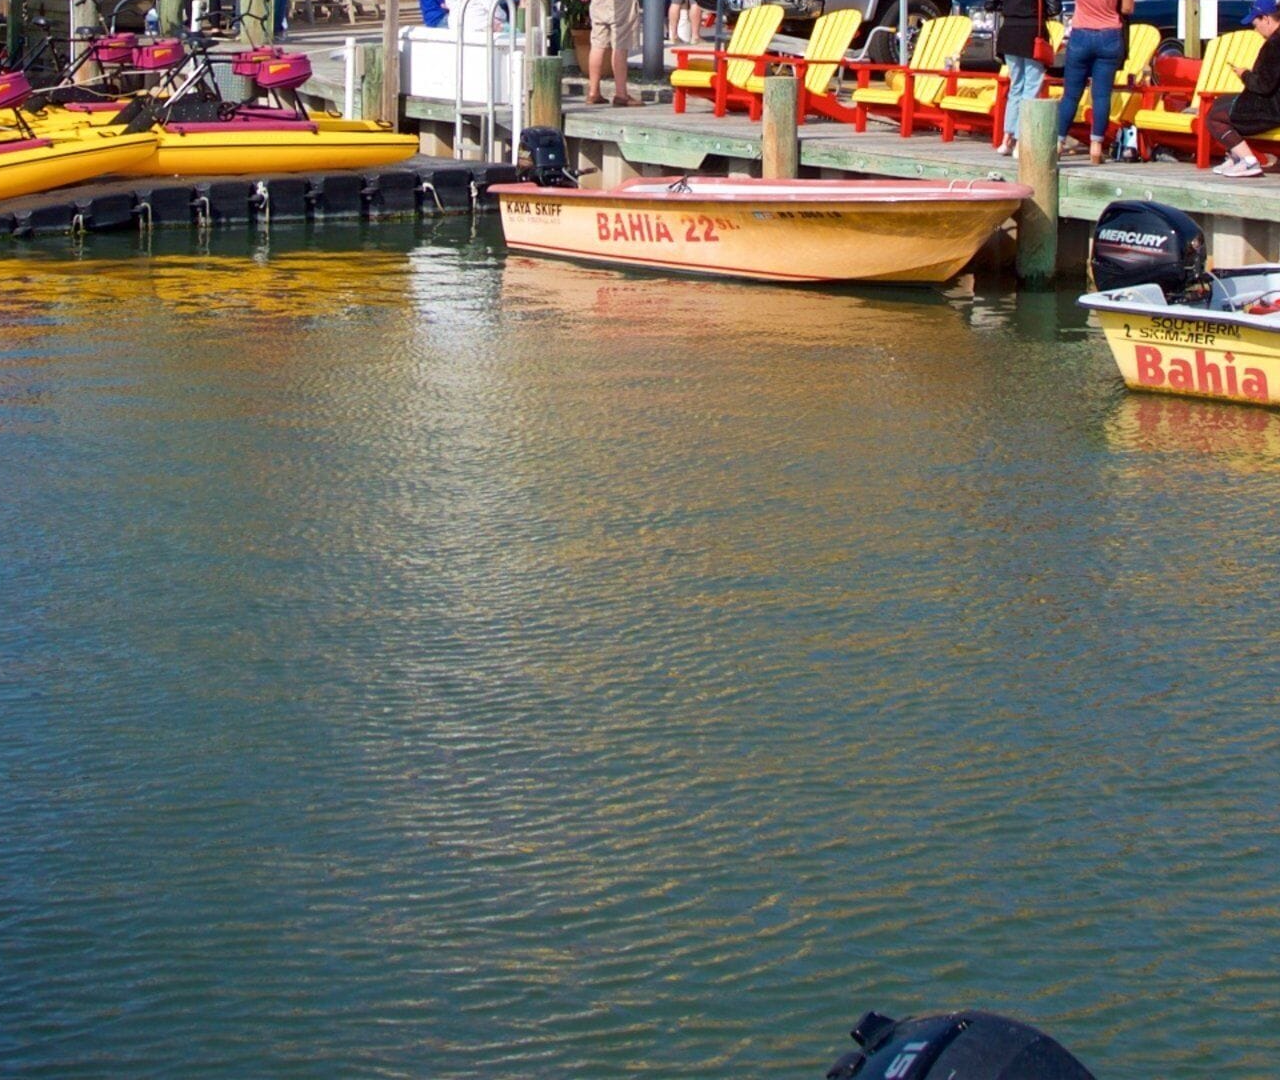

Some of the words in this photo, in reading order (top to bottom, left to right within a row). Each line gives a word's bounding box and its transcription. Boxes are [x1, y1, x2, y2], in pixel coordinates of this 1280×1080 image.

[506, 200, 531, 215] KAYA
[535, 203, 562, 216] SKIFF
[596, 212, 674, 243] BAHIA
[680, 215, 720, 242] 22
[1098, 229, 1168, 247] MERCURY
[1123, 323, 1132, 338] 2
[1151, 316, 1238, 336] SOUTHERN
[1134, 344, 1270, 402] Bahia
